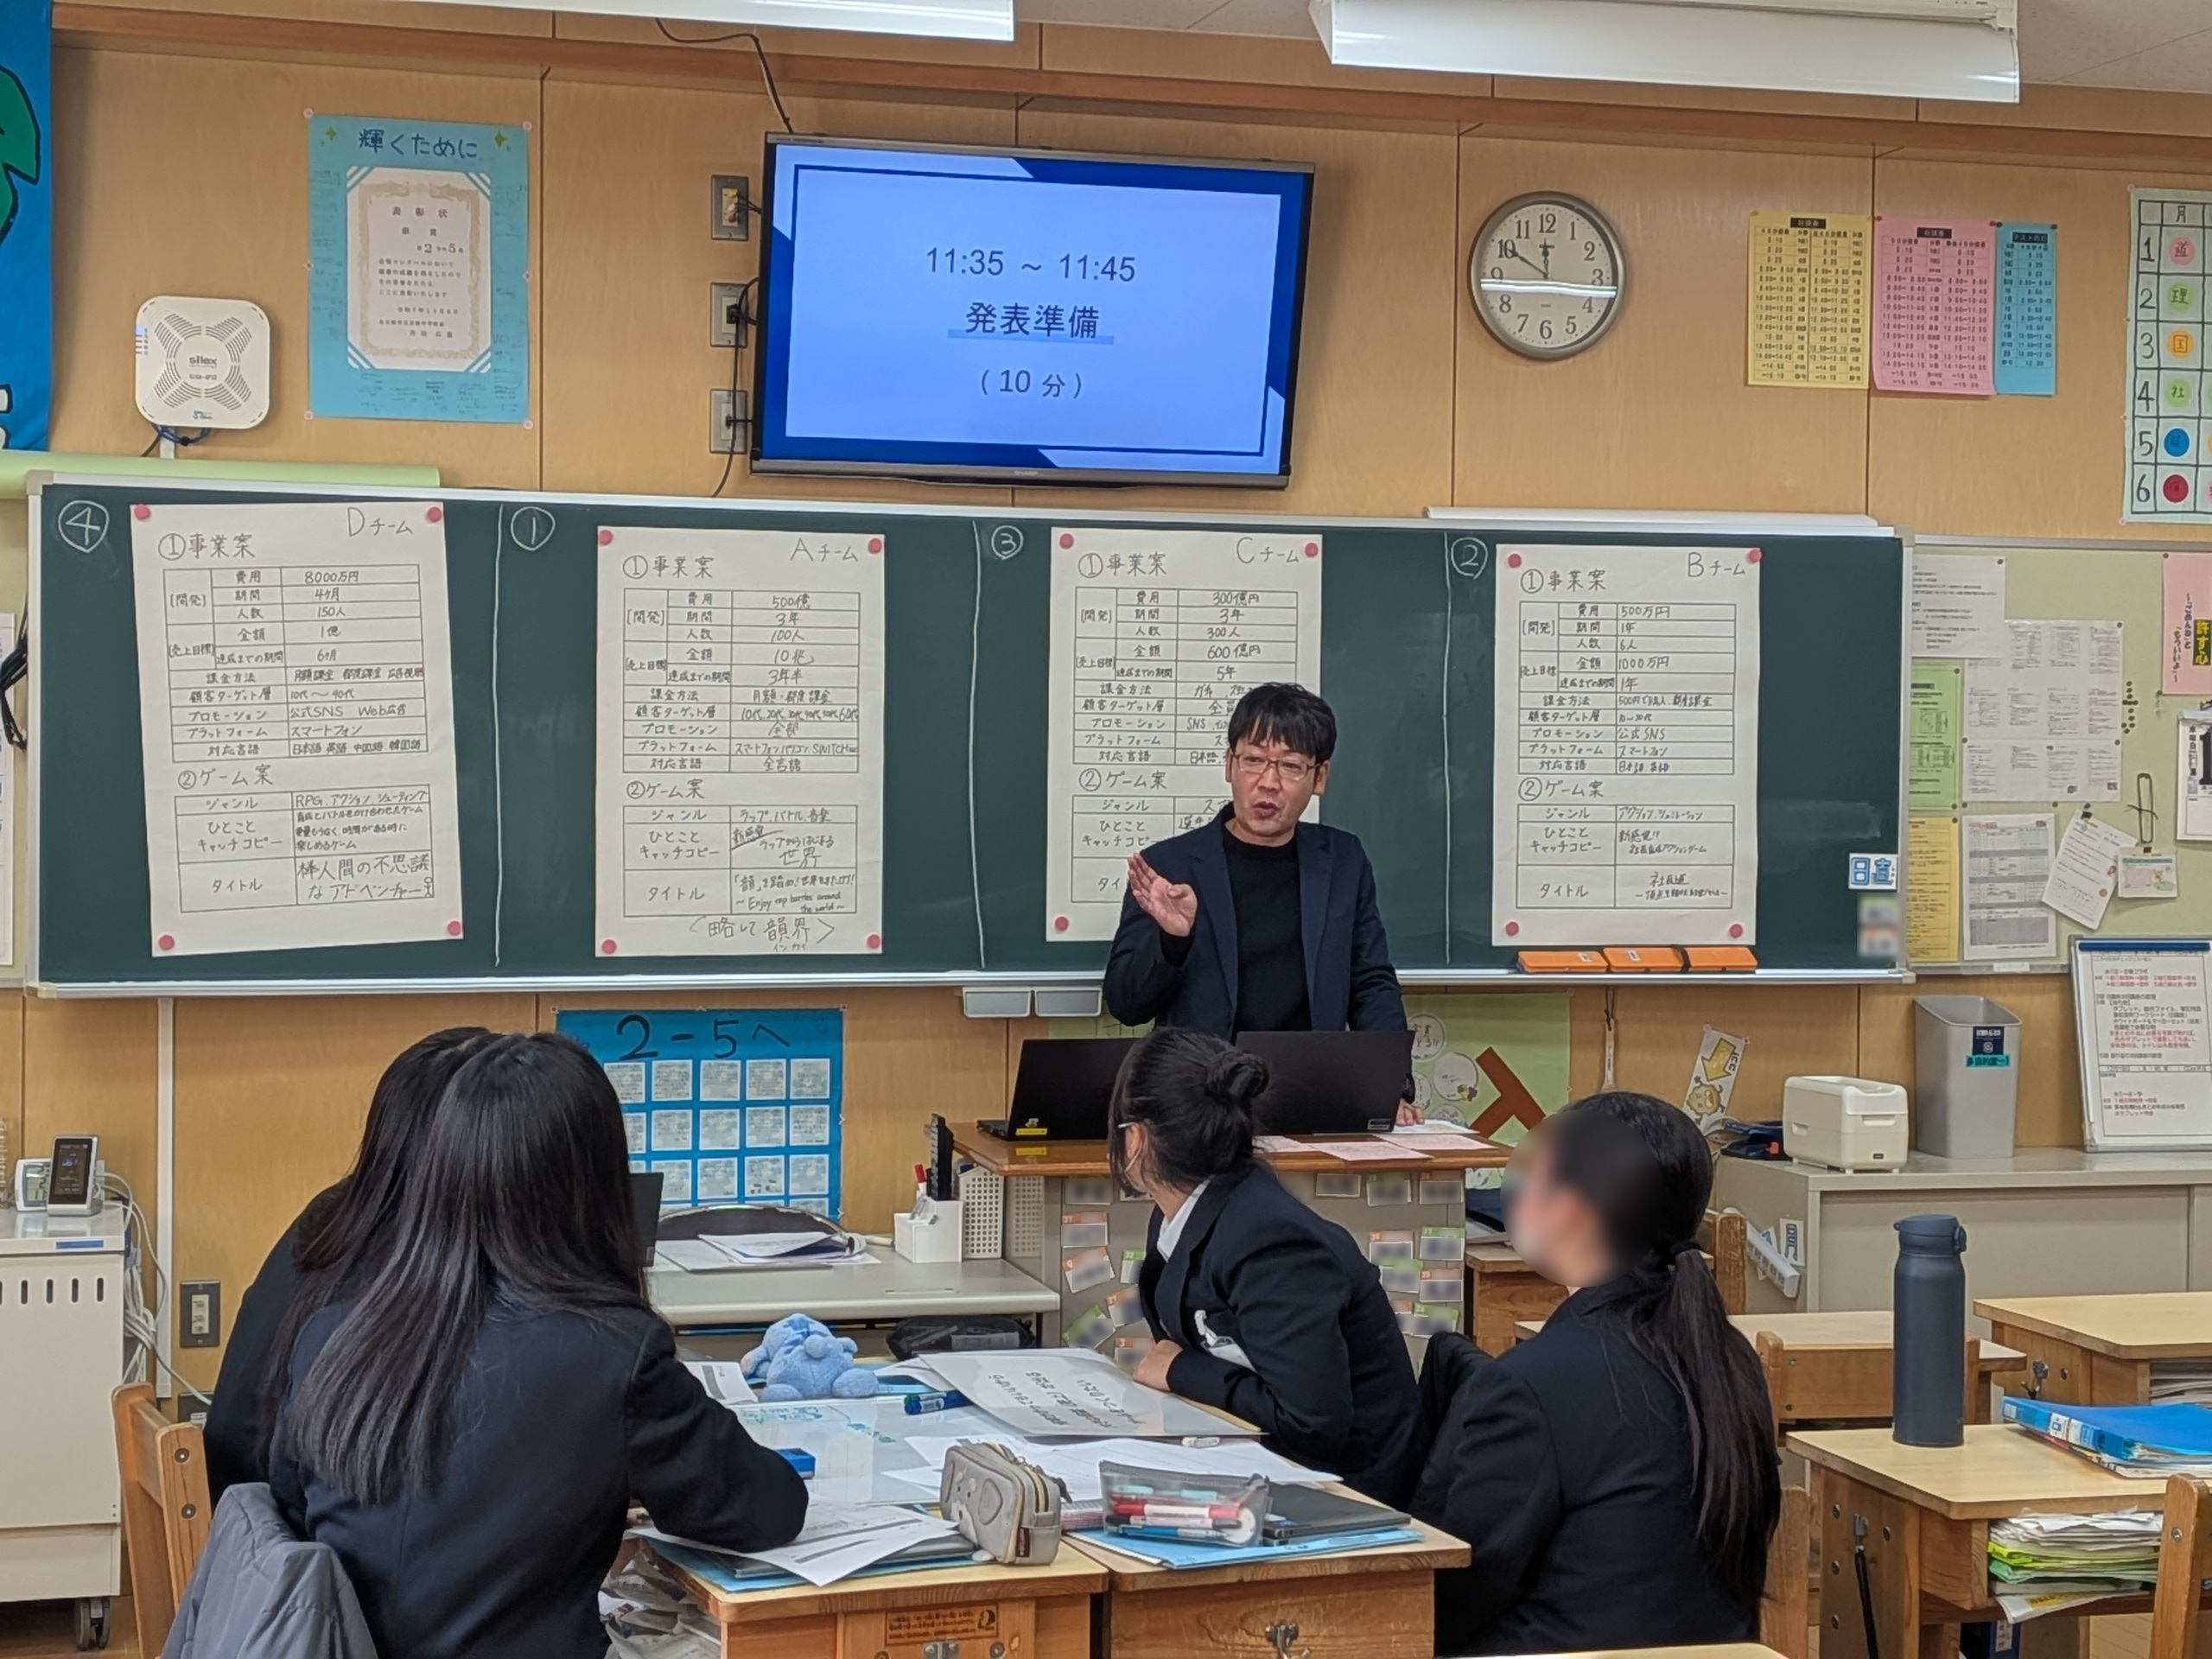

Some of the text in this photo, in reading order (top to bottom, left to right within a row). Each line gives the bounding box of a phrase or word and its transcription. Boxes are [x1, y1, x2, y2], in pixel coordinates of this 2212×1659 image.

[358, 129, 478, 158] 輝くために
[2177, 206, 2186, 223] 月
[1516, 219, 1529, 239] 11
[1539, 213, 1555, 233] 12
[1570, 221, 1575, 240] 1
[1498, 239, 1516, 258] 10
[1585, 242, 1595, 261] 2
[2141, 237, 2155, 262] 1
[925, 246, 1136, 283] 11:35 11:45
[1592, 270, 1603, 286] 3
[1499, 295, 1511, 313] 8
[1582, 296, 1593, 313] 4
[2139, 288, 2189, 308] 2 理
[965, 302, 1100, 339] 発表準備
[1517, 315, 1529, 333] 7
[1566, 316, 1576, 334] 5
[1540, 320, 1552, 339] 6
[2141, 333, 2154, 359] 3
[2137, 381, 2154, 411] 4
[2139, 431, 2153, 456] 5
[2137, 474, 2150, 503] 6
[236, 570, 359, 583] 費用 8000万円
[235, 589, 260, 601] 期間
[688, 592, 810, 609] 費用 500億
[1136, 592, 1259, 606] 費用 300億円
[238, 606, 345, 620] 人数 150人
[1135, 609, 1244, 623] 期間 3年
[1578, 605, 1670, 618] 費用 500万円
[687, 612, 712, 623] 期間
[776, 613, 799, 626] 3年
[238, 627, 265, 641] 金額
[1135, 626, 1240, 638] 人数 300人
[1576, 621, 1599, 632] 期間
[1621, 622, 1637, 633] 1年
[687, 629, 804, 642] 人数 100人
[1577, 638, 1637, 650] 人数 6人
[217, 651, 283, 664] 達成までの期間
[686, 648, 712, 661] 金額
[1134, 645, 1261, 658] 金額 600億円
[1577, 656, 1669, 670] 金額 1000万円
[206, 672, 256, 683] 課金方法
[668, 670, 803, 685] 達成までの期間 3年半
[1116, 665, 1236, 680] 達成までの期間 5年
[1101, 683, 1151, 695] 課金方法
[1560, 677, 1638, 691] 達成までの期間 1年
[190, 687, 271, 702] 顧客ターゲット層
[651, 690, 698, 701] 課金方法
[1543, 695, 1590, 706] 課金方法
[189, 703, 406, 721] プロモーション 公式SNS Web広告
[635, 705, 715, 717] 顧客ターゲット層
[1083, 700, 1165, 712] 顧客ターゲット層
[1528, 710, 1599, 722] 顧客ターゲット層
[643, 724, 718, 734] プロモーション
[1092, 718, 1165, 728] プロモーション
[1187, 717, 1205, 730] SNS
[187, 725, 362, 738] プラットフォーム スマートフォン
[1084, 733, 1160, 744] プラットフォーム
[1532, 728, 1666, 740] プロモーション 公式SNS
[207, 743, 259, 757] 対応言語
[639, 741, 716, 752] プラットフォーム
[1529, 744, 1603, 755] プラットフォーム
[1099, 750, 1151, 761] 対応言語
[650, 756, 801, 772] 対応言語 全言語
[1539, 760, 1586, 771] 対応言語
[207, 799, 257, 810] ジャンル
[1103, 799, 1148, 810] ジャンル
[652, 810, 707, 820] ジャンル
[1546, 808, 1590, 819] ジャンル
[208, 822, 256, 834] ひとこと
[1100, 821, 1146, 832] ひとこと
[1545, 828, 1588, 838] ひとこと
[198, 836, 282, 851] キャッチコピー
[650, 831, 699, 843] ひとこと
[1083, 834, 1159, 847] キャッチコピー
[297, 841, 357, 851] 楽しめるゲーム
[1530, 842, 1601, 853] キャッチコピー
[639, 846, 822, 868] キャッチコピー 世界
[213, 854, 429, 893] タイトル 棒人間の不思議
[1852, 857, 1893, 885] 日直
[1098, 877, 1121, 891] タイ
[1541, 884, 1588, 898] タイトル
[308, 883, 422, 901] なアドベンチャー
[648, 887, 705, 900] タイトル
